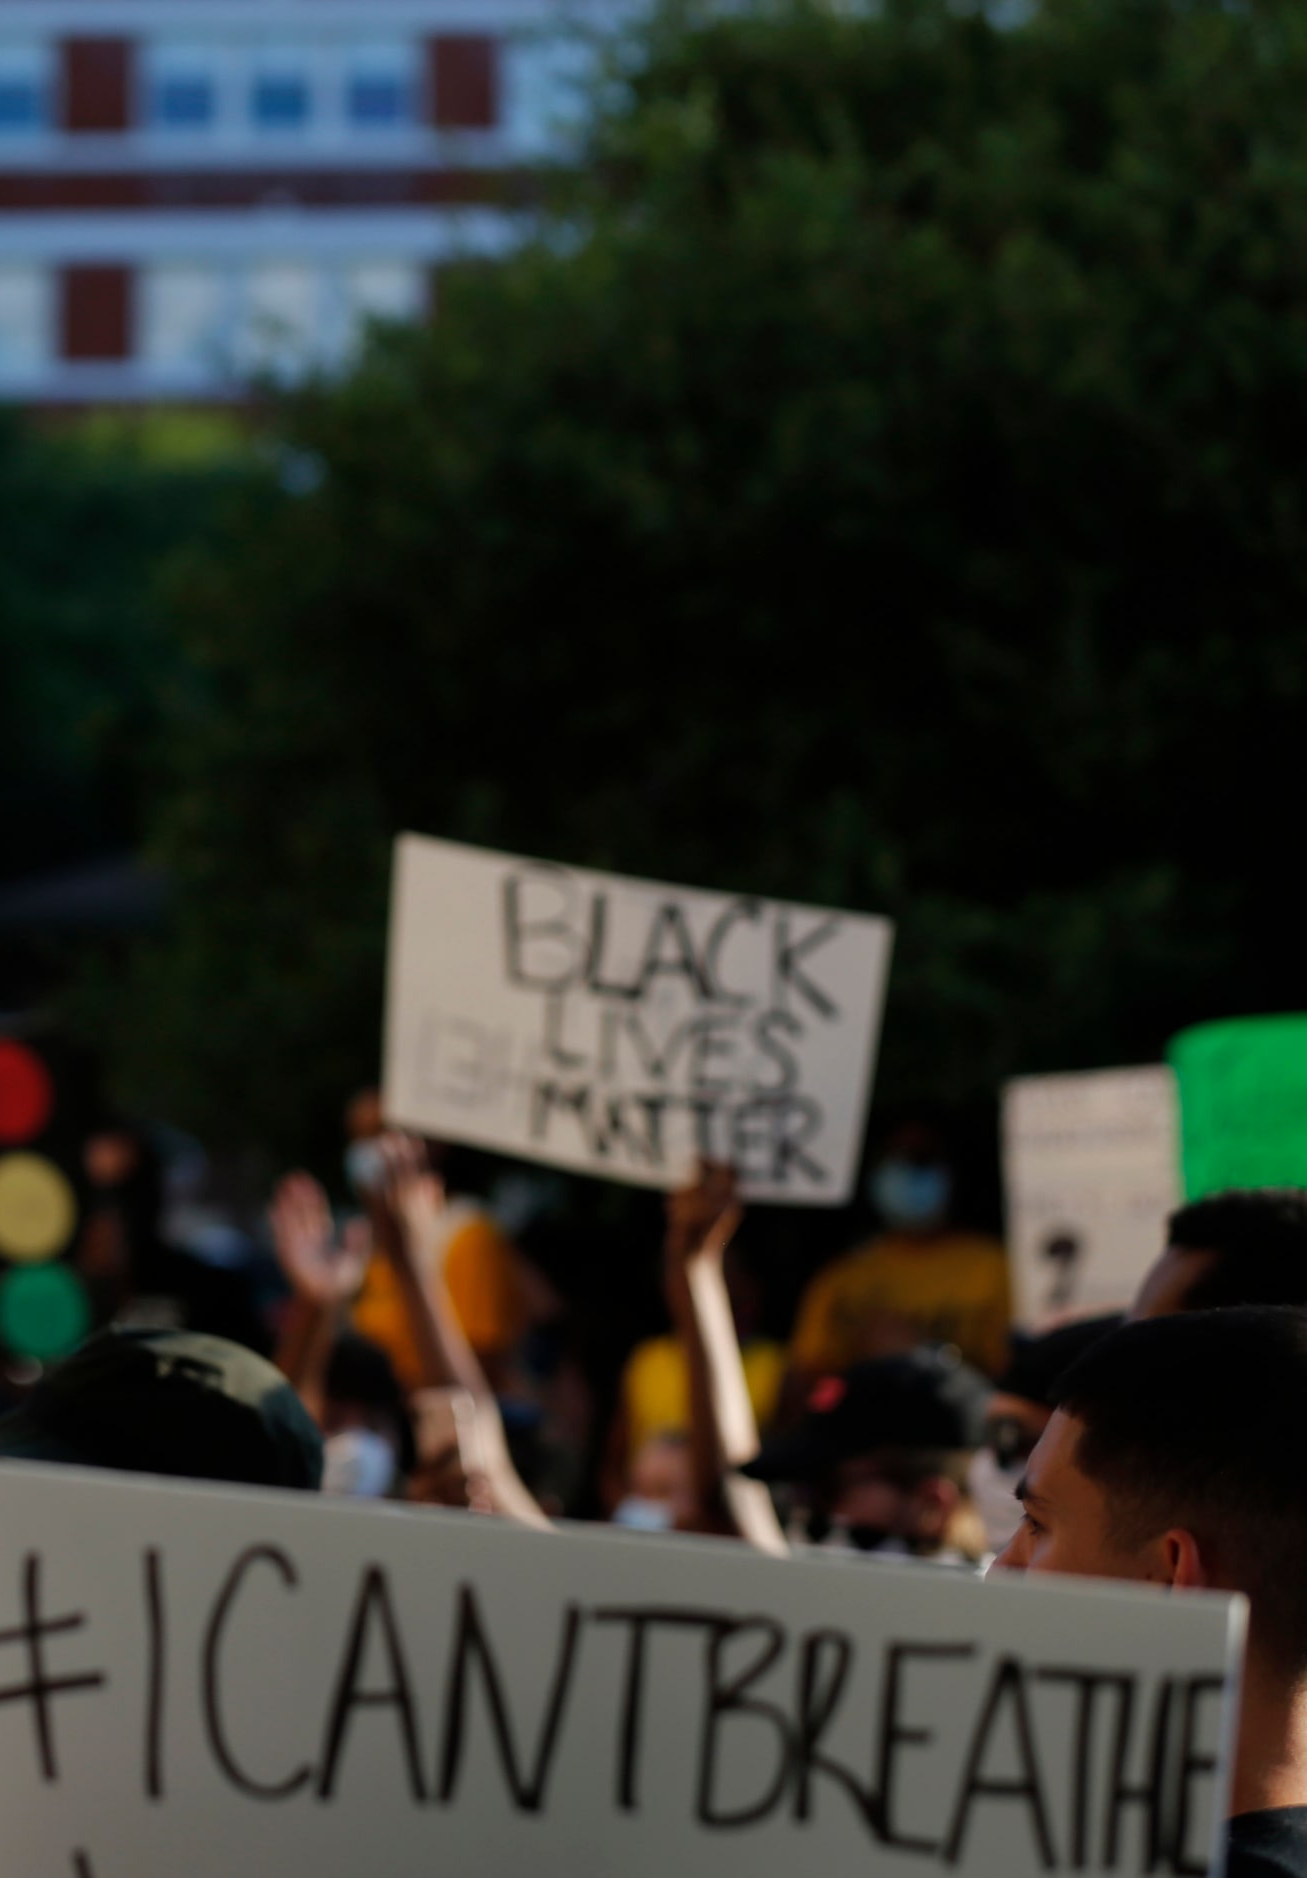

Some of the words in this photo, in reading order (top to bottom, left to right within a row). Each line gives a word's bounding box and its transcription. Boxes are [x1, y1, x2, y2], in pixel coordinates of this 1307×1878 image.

[502, 862, 843, 1023] BLACK
[541, 990, 806, 1094] LIVES
[530, 1078, 837, 1184] MATTER
